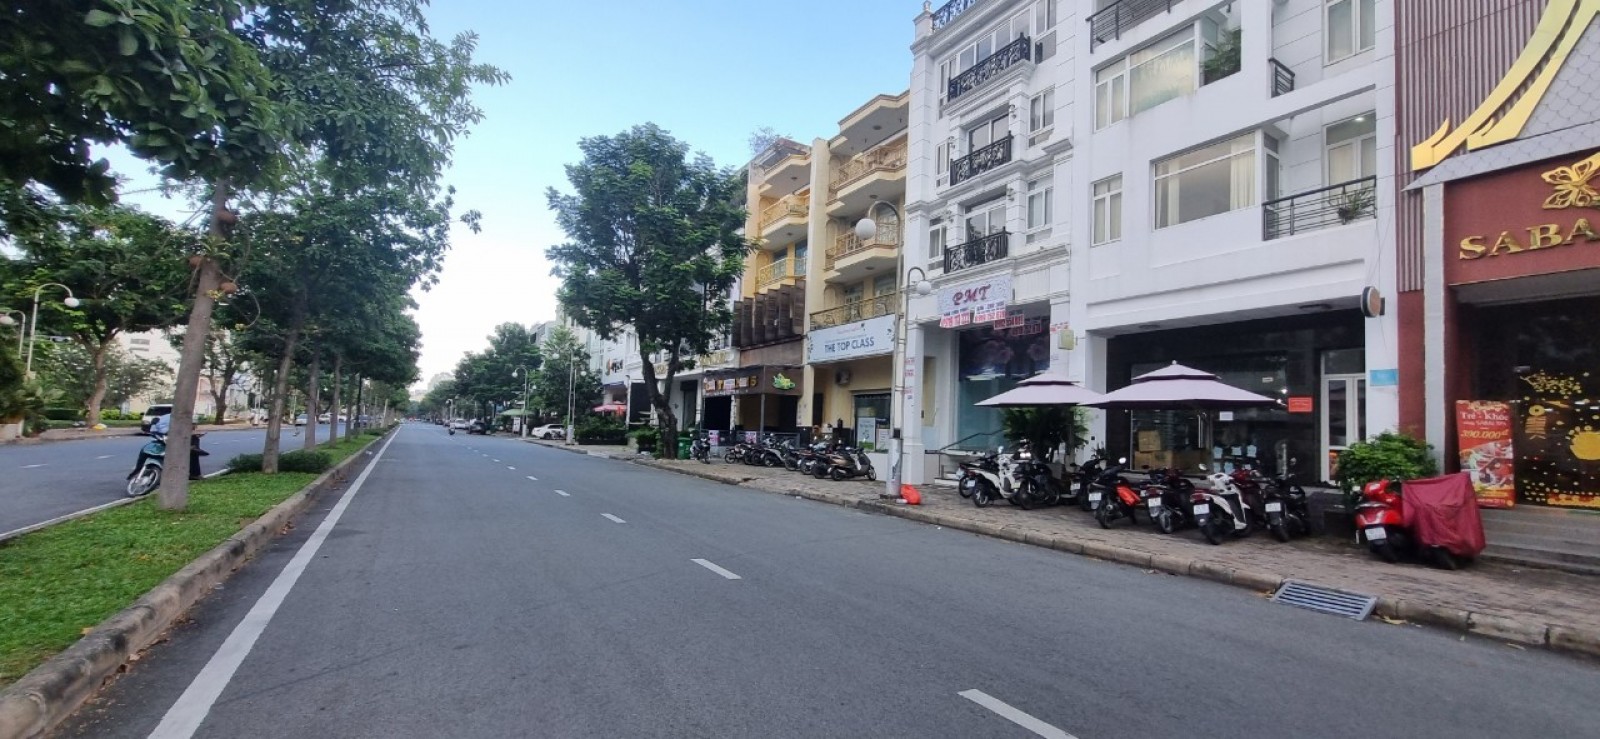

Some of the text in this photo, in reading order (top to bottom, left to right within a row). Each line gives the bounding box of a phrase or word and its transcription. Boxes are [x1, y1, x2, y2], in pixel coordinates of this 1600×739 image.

[953, 284, 991, 306] PMT
[825, 343, 835, 353] THE
[837, 340, 850, 351] TOP
[851, 336, 874, 349] CLASS
